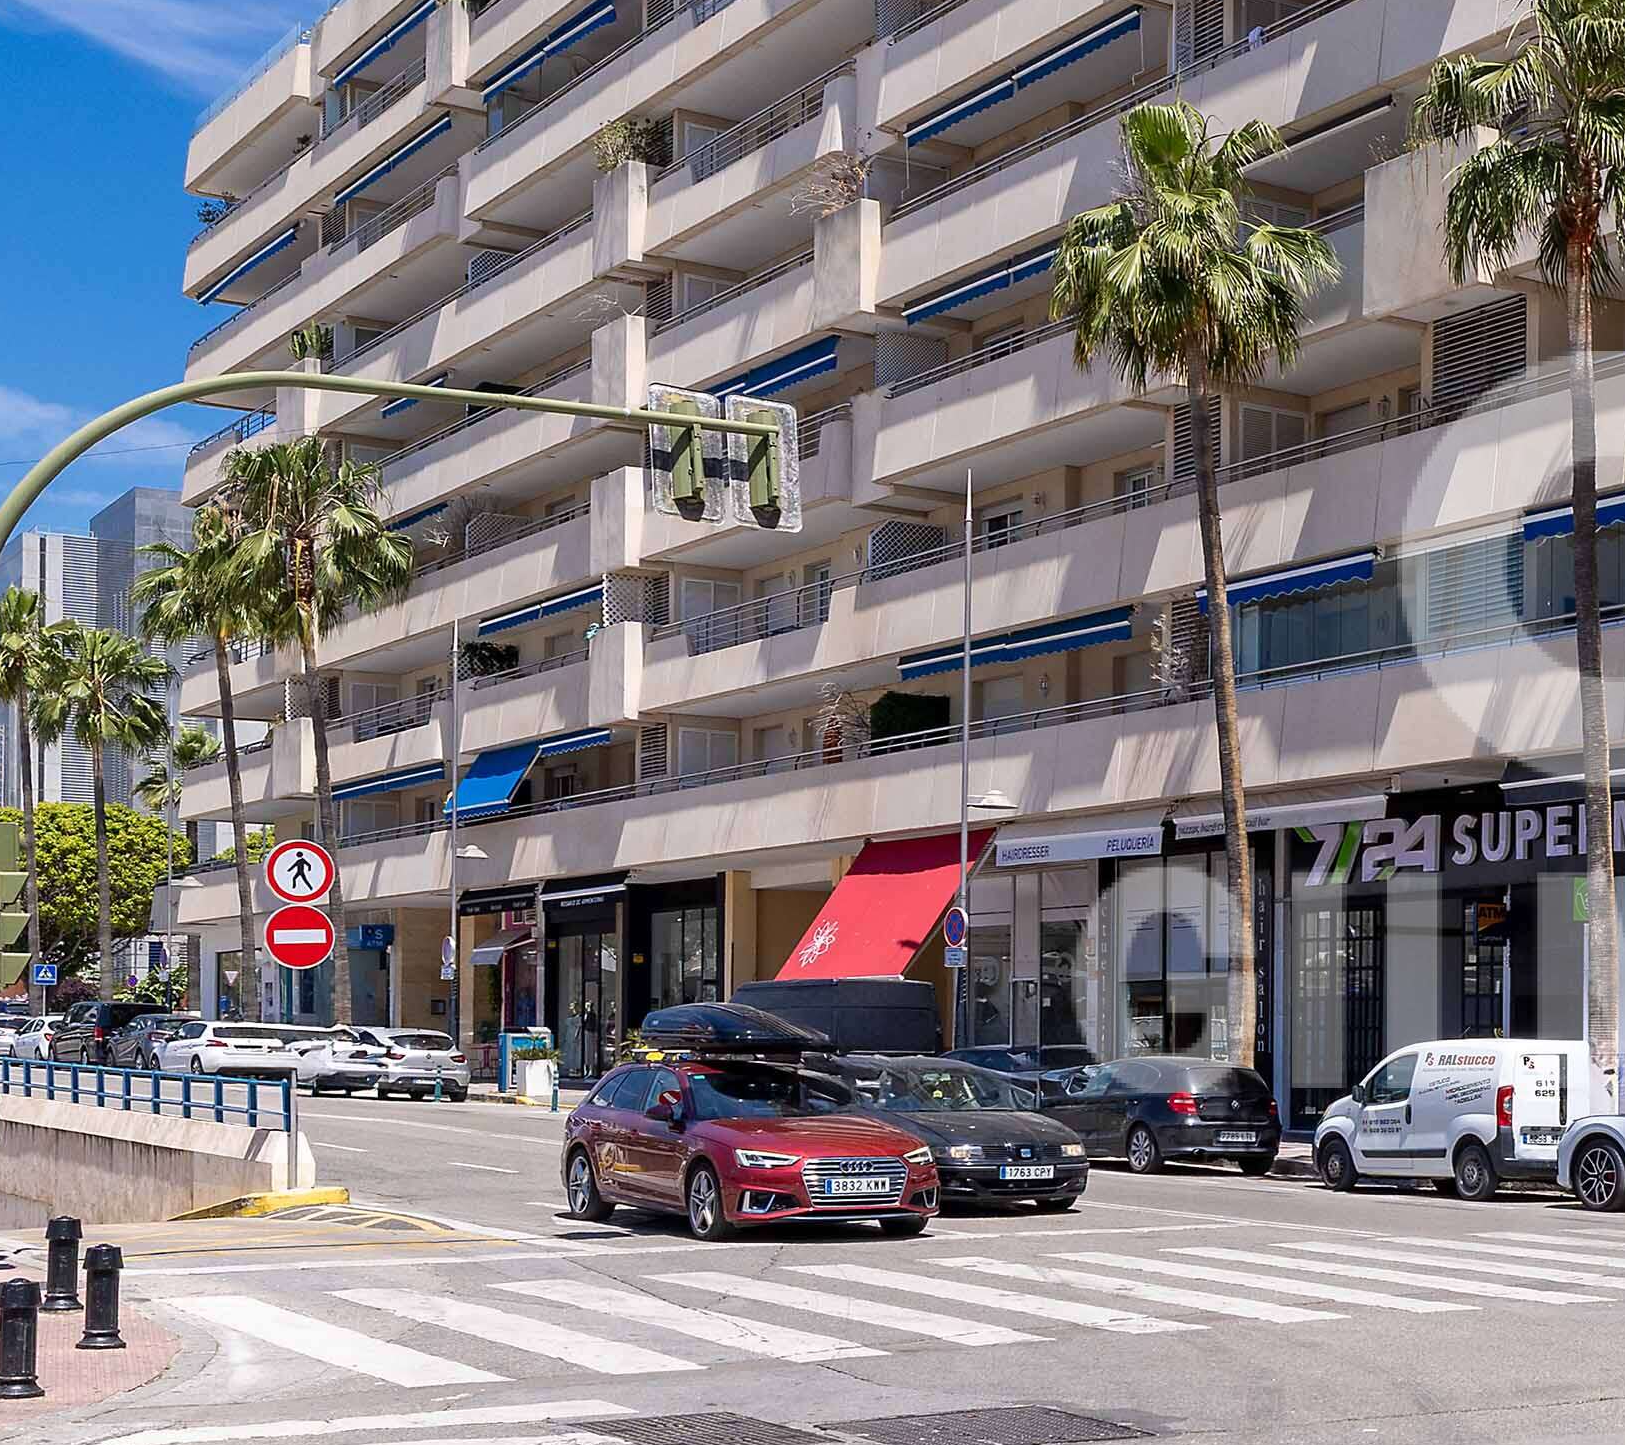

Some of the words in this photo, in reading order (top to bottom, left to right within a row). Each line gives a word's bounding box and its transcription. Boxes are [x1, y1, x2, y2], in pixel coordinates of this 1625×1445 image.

[1002, 845, 1050, 862] HAIRDRESSER
[1106, 835, 1154, 852] PELUQUERÍA
[1438, 1054, 1496, 1066] RALstucco
[1534, 1089, 1556, 1097] 629
[1008, 1167, 1032, 1178] 1763
[833, 1179, 863, 1192] 3832
[865, 1179, 888, 1192] KWW
